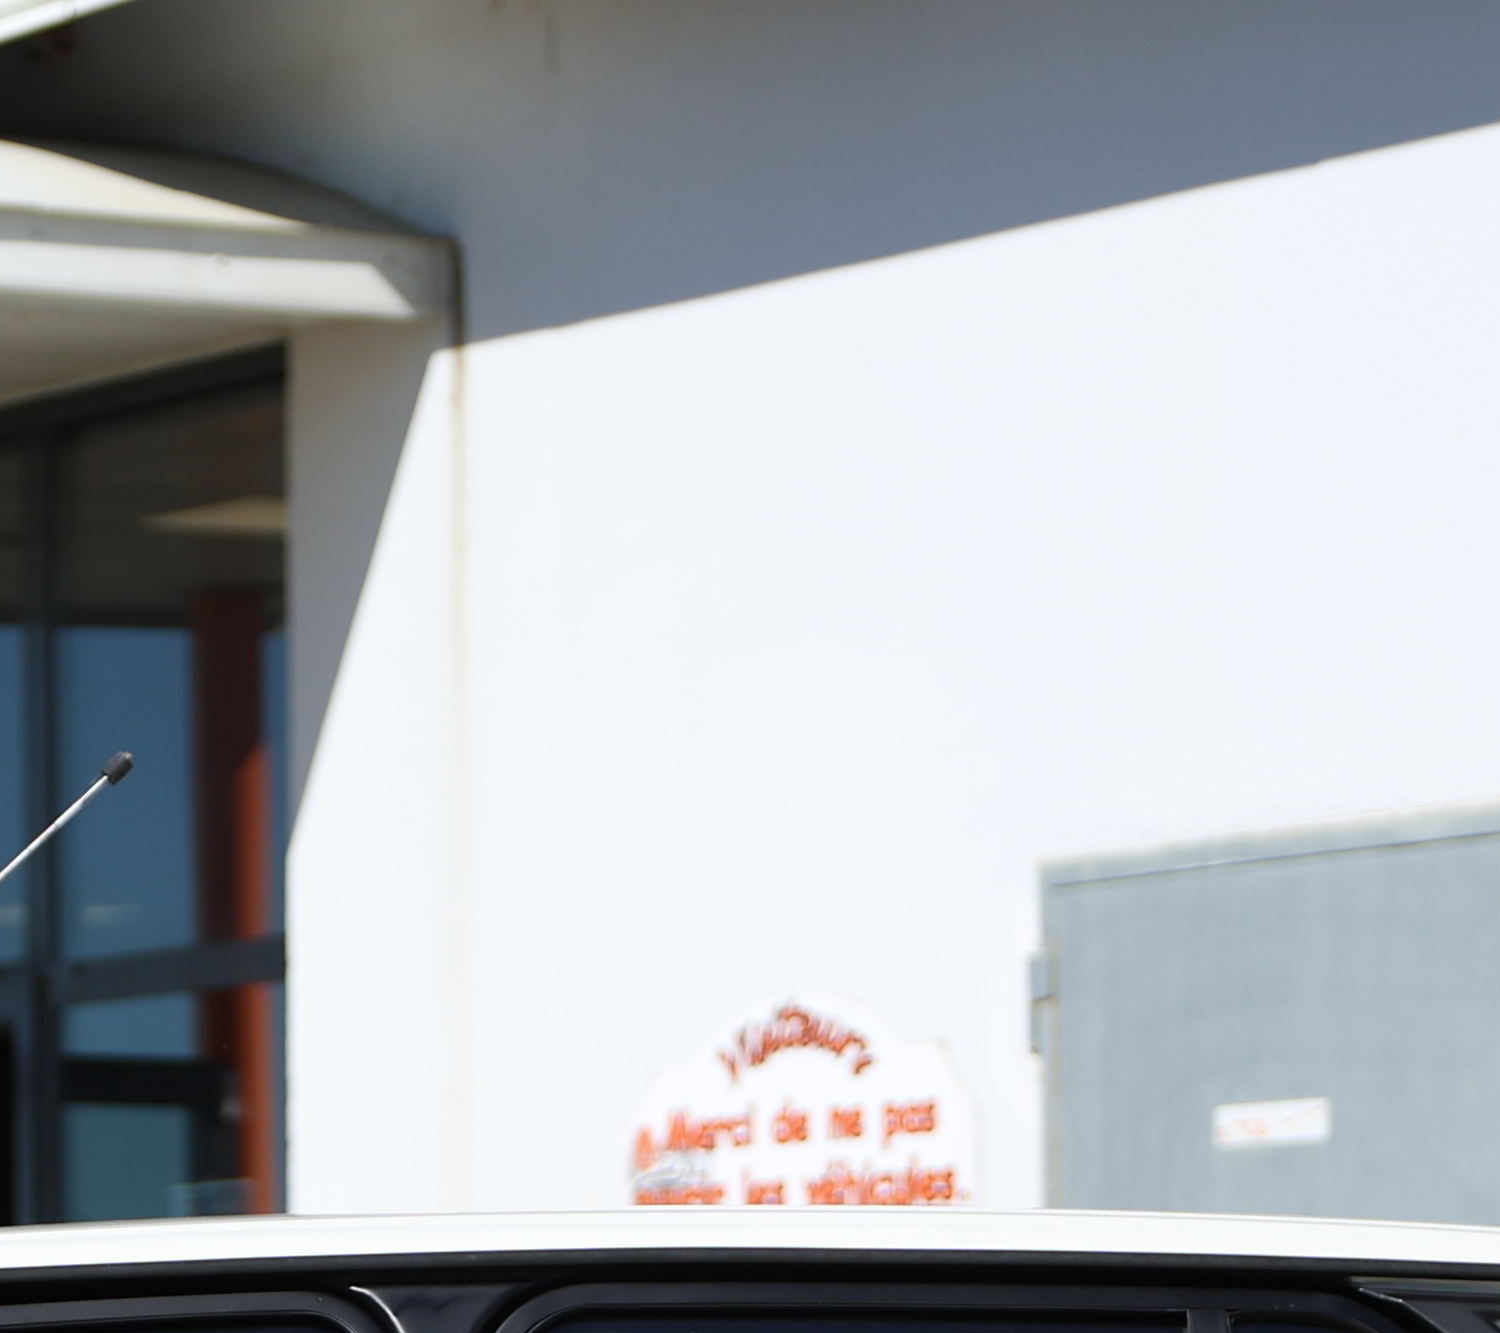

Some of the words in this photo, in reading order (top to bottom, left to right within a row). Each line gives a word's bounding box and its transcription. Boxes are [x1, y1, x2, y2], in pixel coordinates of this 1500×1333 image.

[773, 1100, 810, 1144] de
[829, 1106, 864, 1139] ne
[882, 1100, 938, 1148] pas
